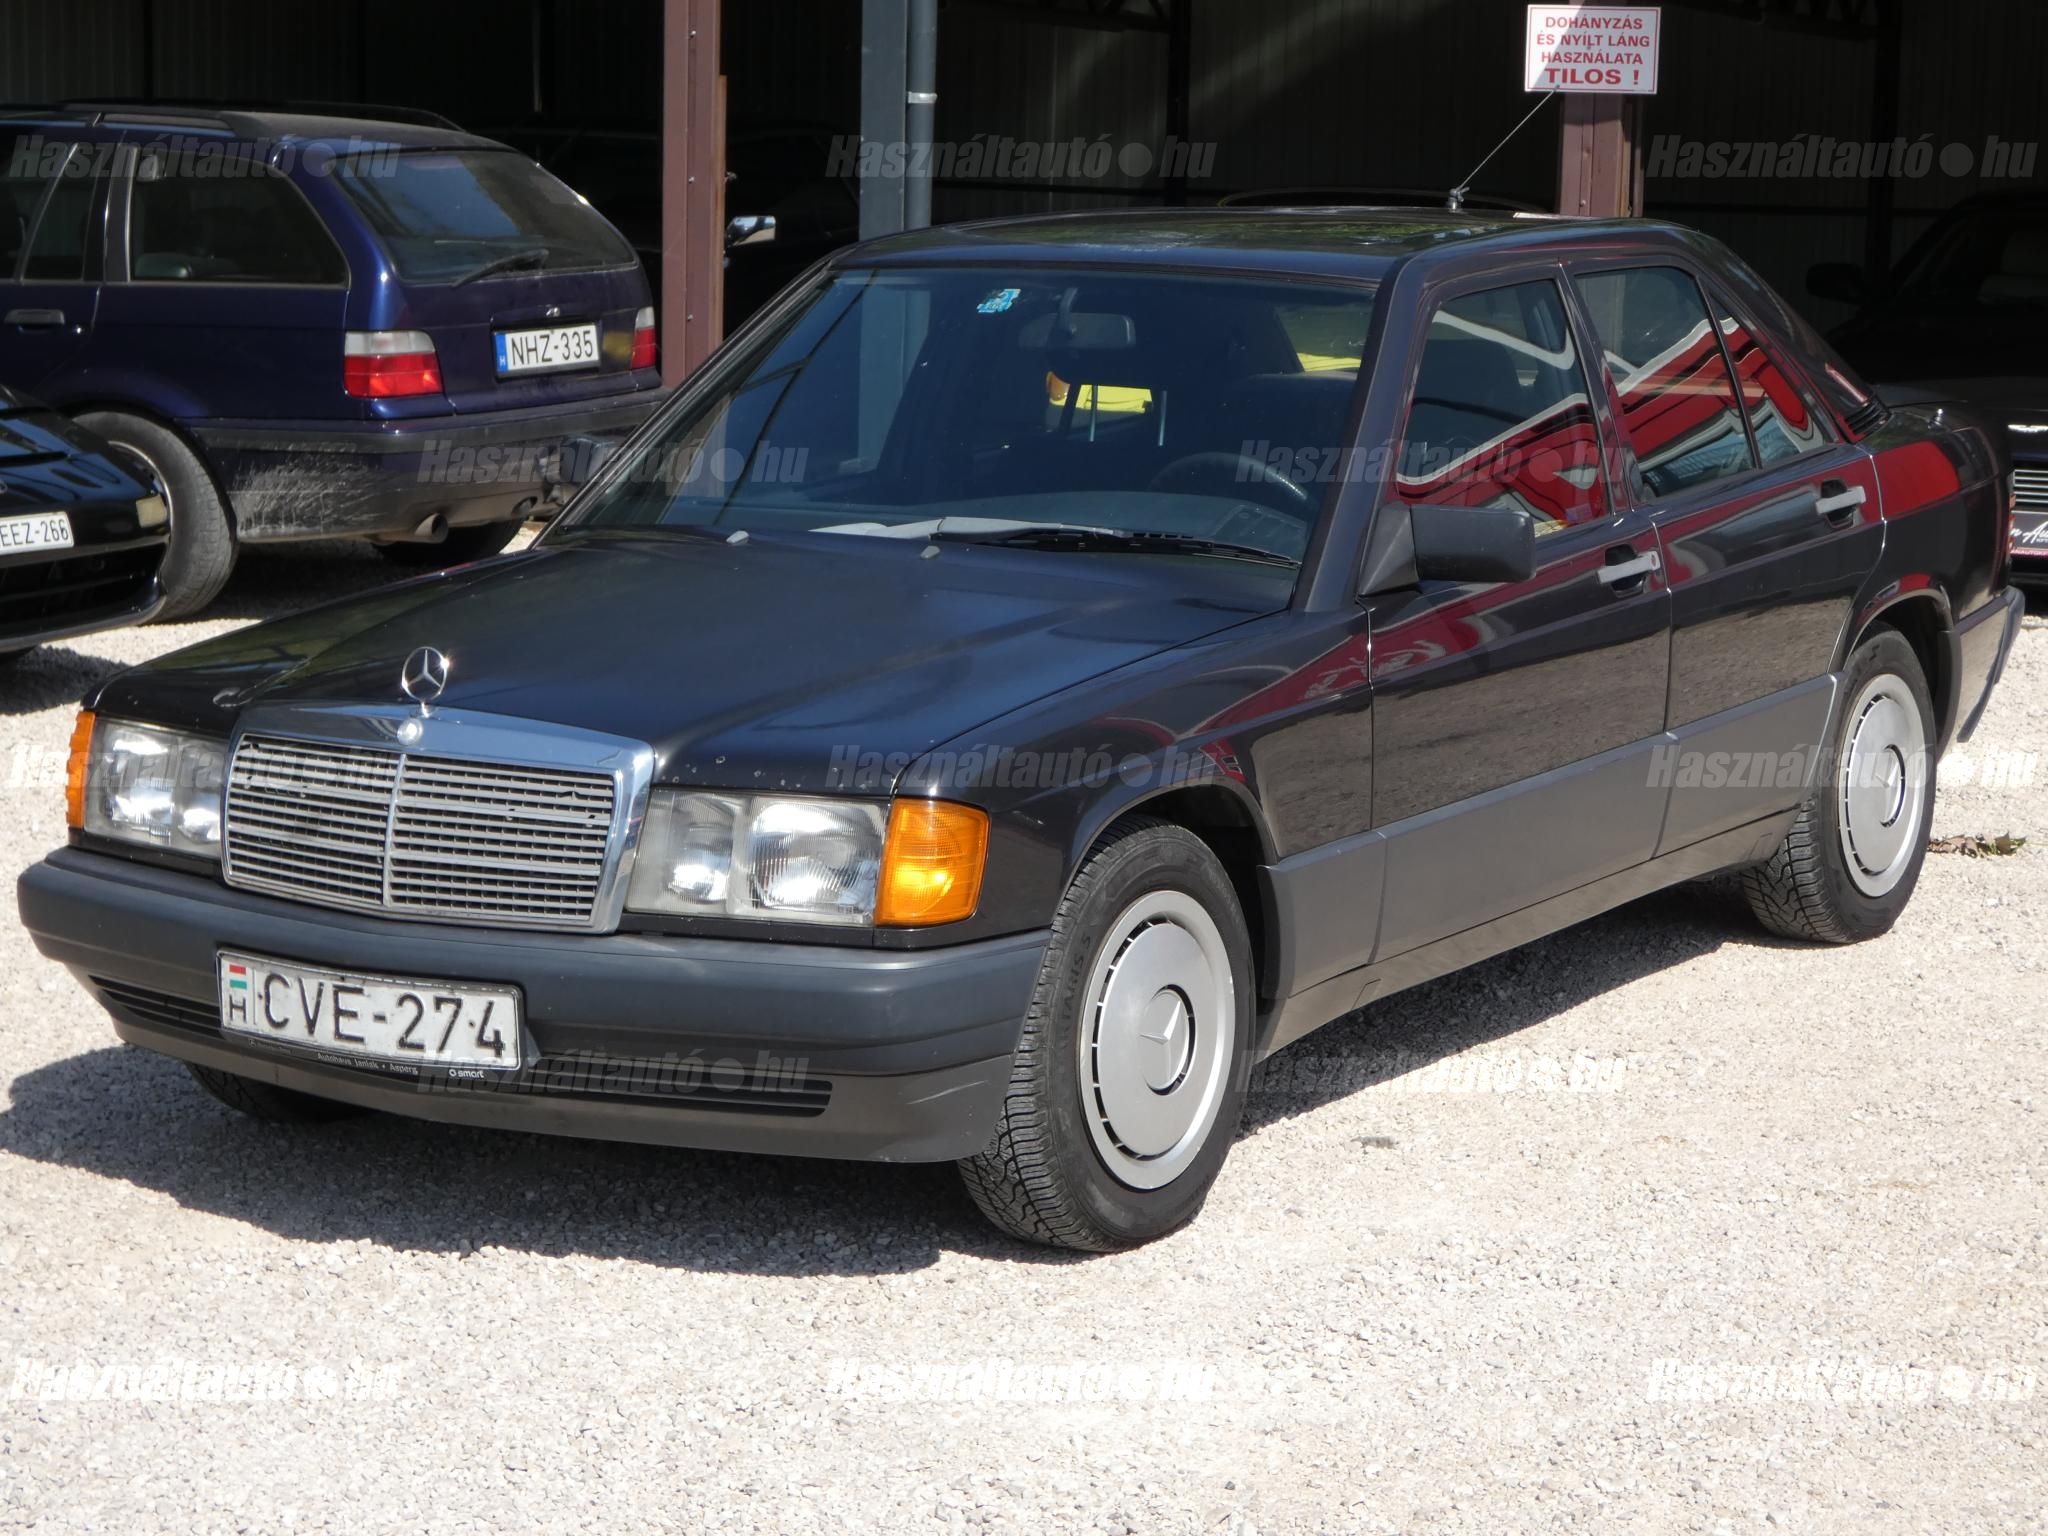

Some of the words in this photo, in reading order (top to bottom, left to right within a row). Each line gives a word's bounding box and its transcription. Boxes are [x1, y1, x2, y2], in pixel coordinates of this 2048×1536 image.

[1545, 15, 1643, 30] DOHÁNYZÁS
[1536, 29, 1555, 46] ÉS
[1560, 31, 1603, 48] NYÍLT
[1608, 31, 1650, 48] LÁNG
[1541, 49, 1644, 65] HASZNÁLATA
[1544, 68, 1621, 85] TILOS
[511, 329, 593, 367] NHZ-335
[264, 973, 505, 1059] CVE-274
[457, 1070, 485, 1079] smart
